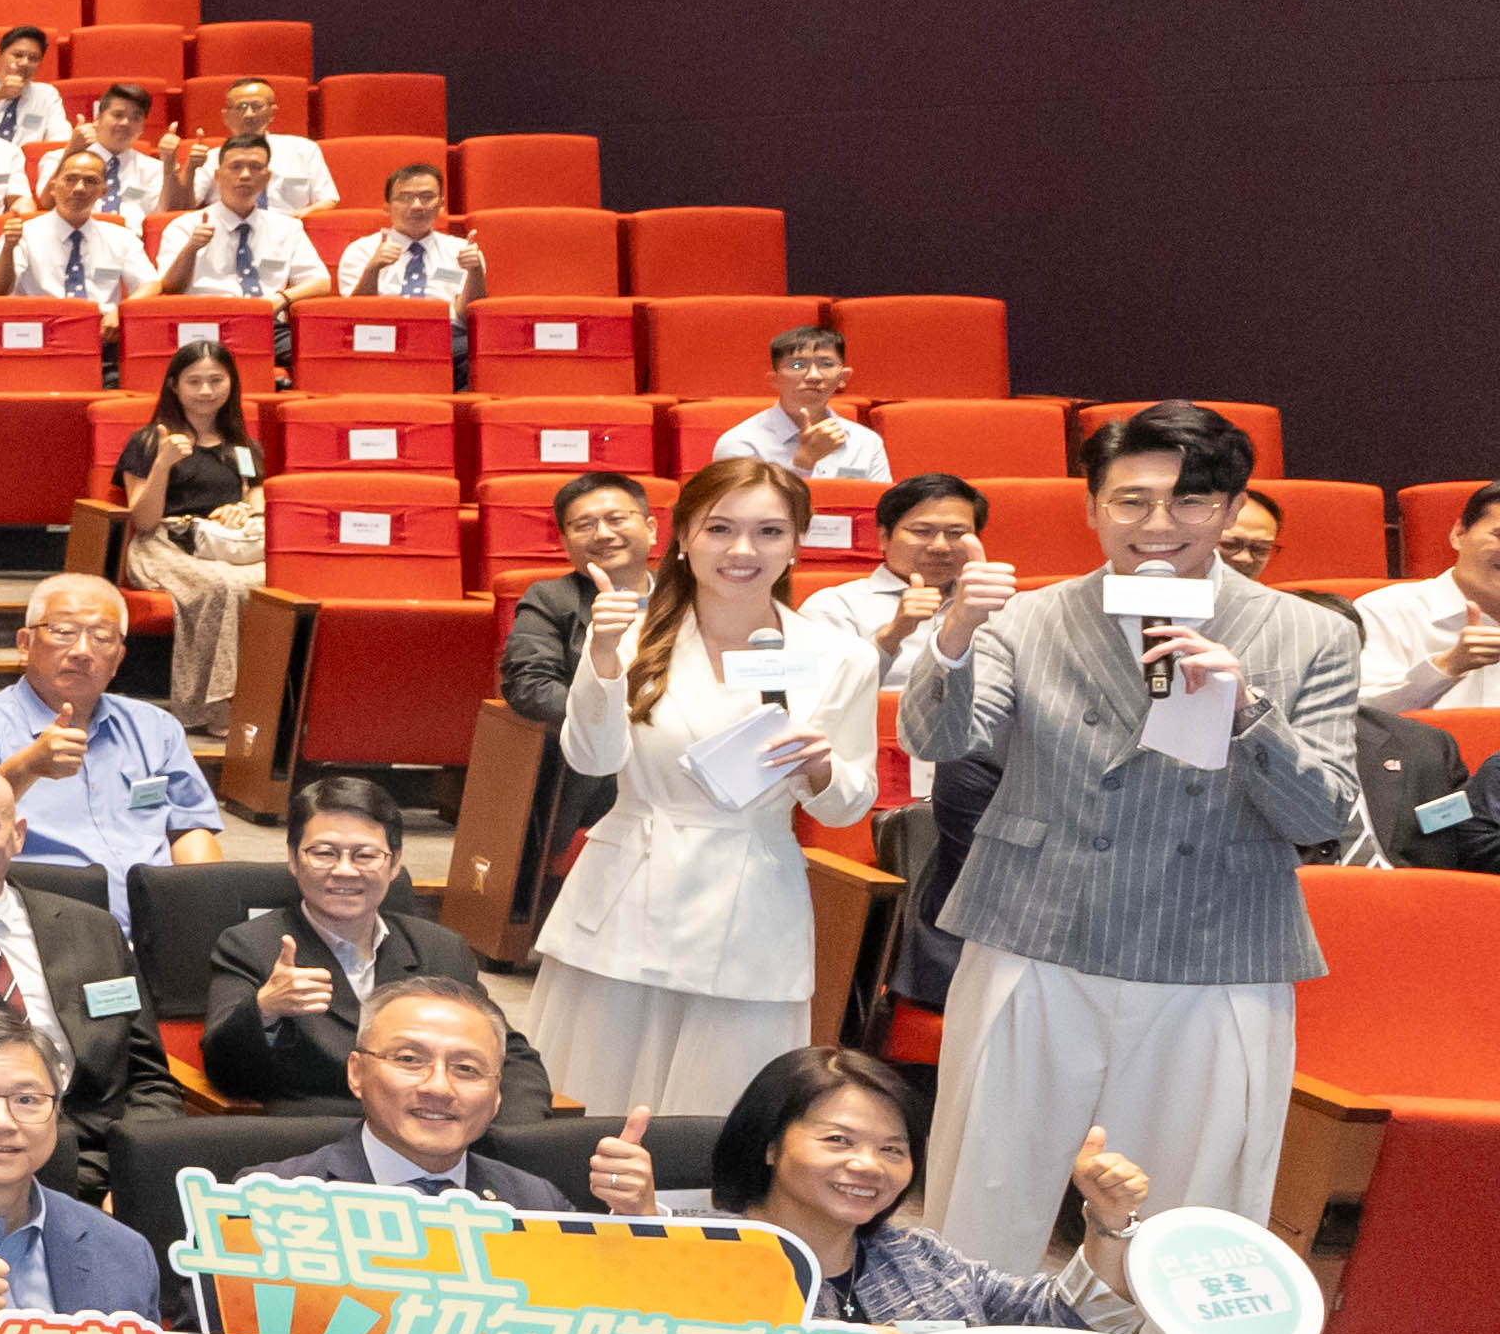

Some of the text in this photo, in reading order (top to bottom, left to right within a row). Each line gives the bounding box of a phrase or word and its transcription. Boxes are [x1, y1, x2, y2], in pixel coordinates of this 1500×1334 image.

[178, 1181, 519, 1296] 上落巴士
[1200, 1273, 1252, 1297] 安全
[1196, 1295, 1273, 1320] SAFETY
